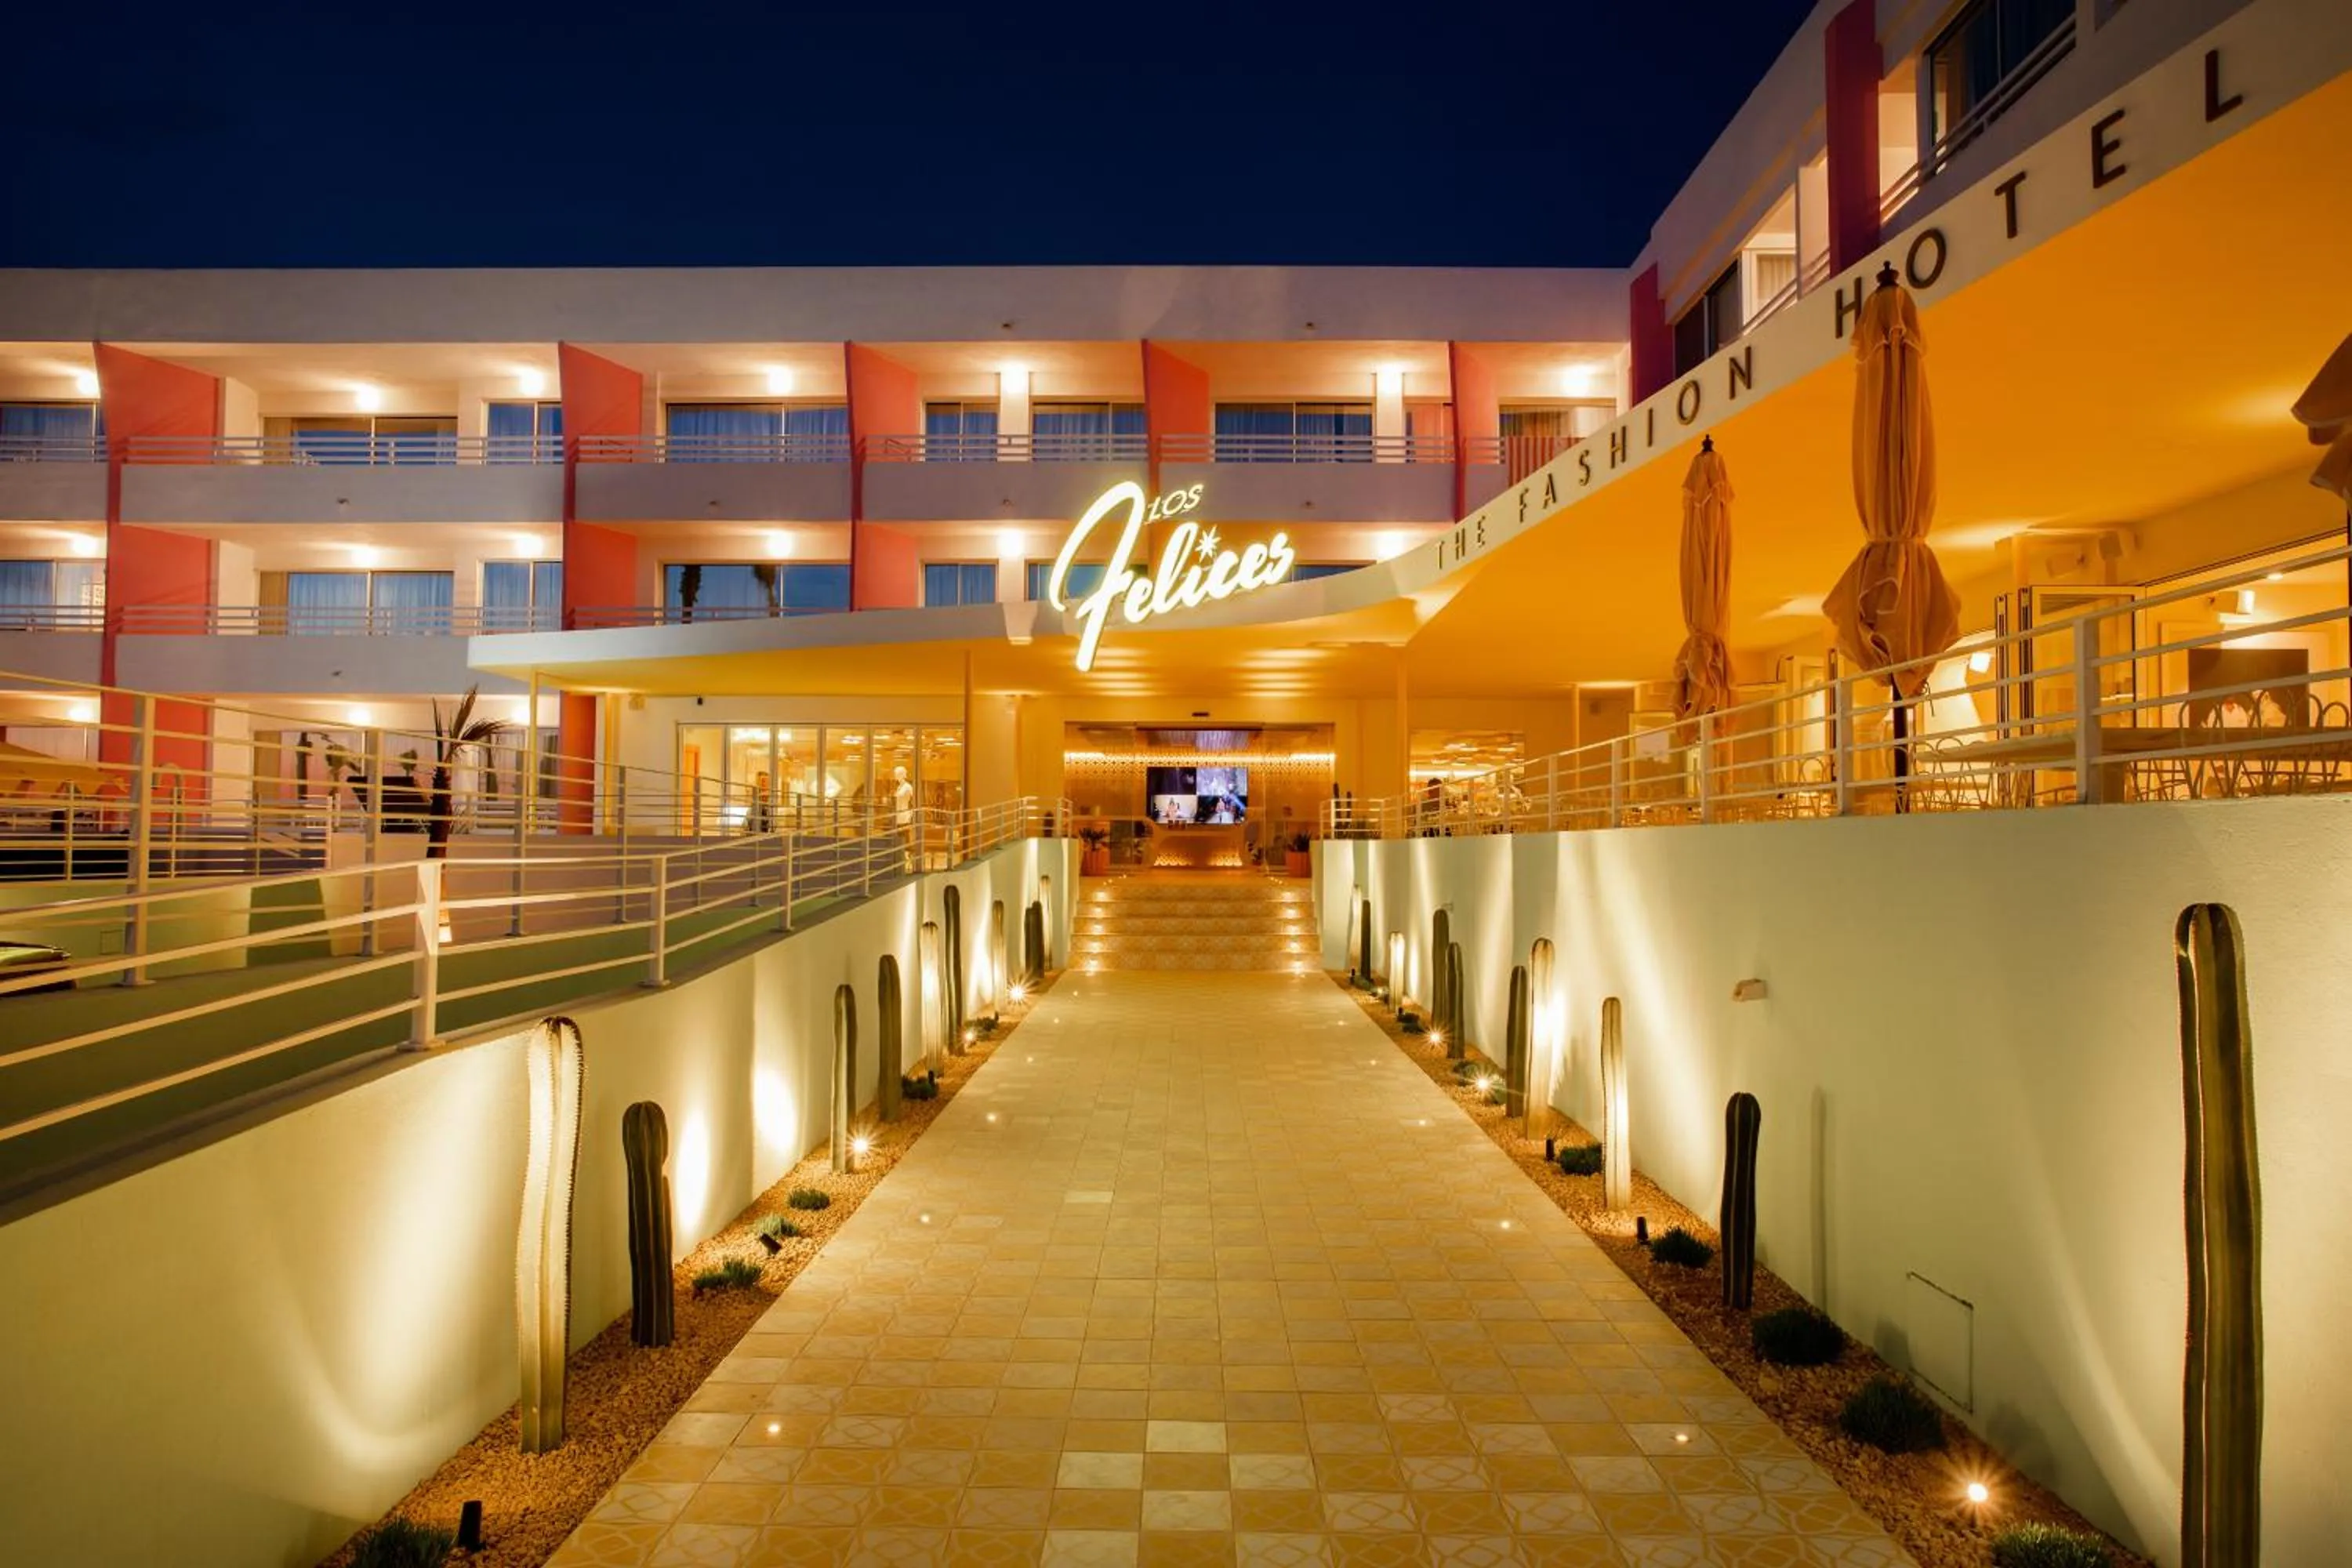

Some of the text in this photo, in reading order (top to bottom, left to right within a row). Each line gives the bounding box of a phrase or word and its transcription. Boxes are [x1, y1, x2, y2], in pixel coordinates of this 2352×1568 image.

[1436, 49, 2244, 570] THE FASHION HOTEL
[1048, 481, 1295, 672] Felices
[1147, 484, 1204, 522] LOS
